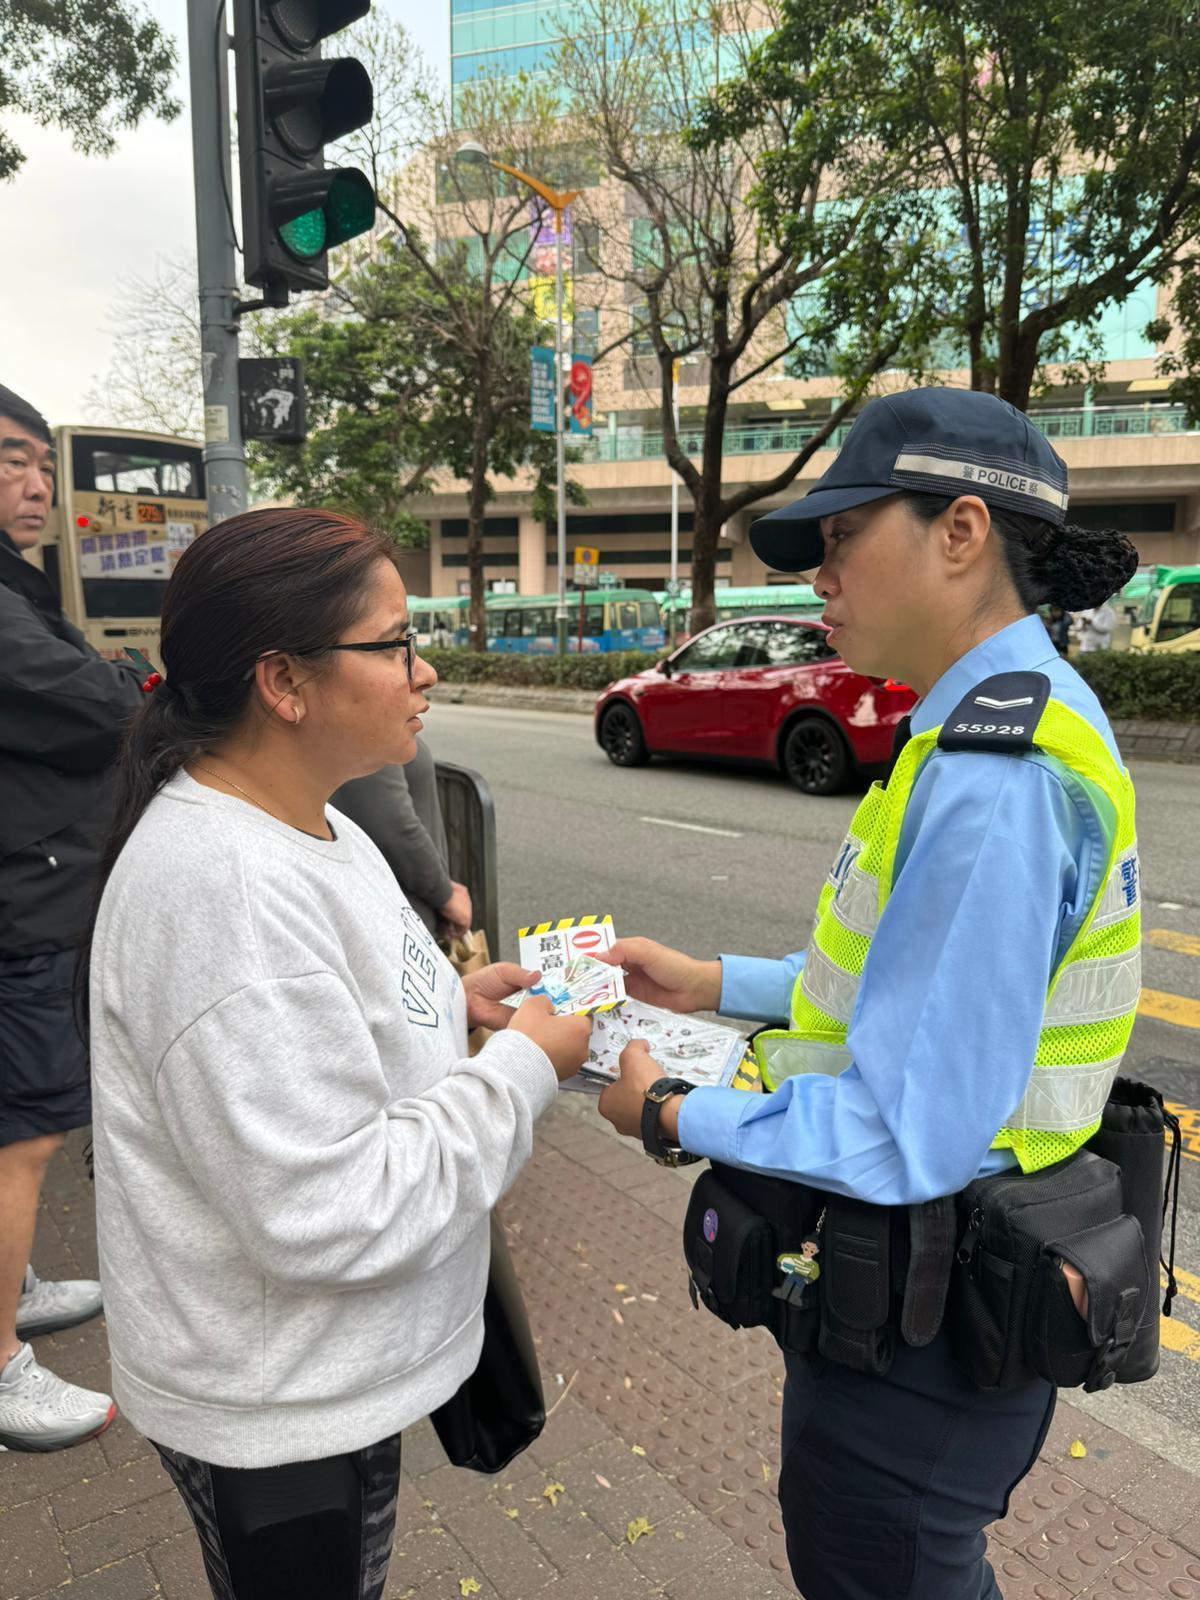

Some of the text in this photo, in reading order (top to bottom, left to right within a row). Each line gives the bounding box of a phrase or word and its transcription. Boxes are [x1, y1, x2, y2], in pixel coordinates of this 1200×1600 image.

[962, 465, 1039, 495] 警 POLICE 察
[128, 627, 161, 636] ENV
[953, 723, 1025, 735] 55928
[540, 934, 564, 972] 最高
